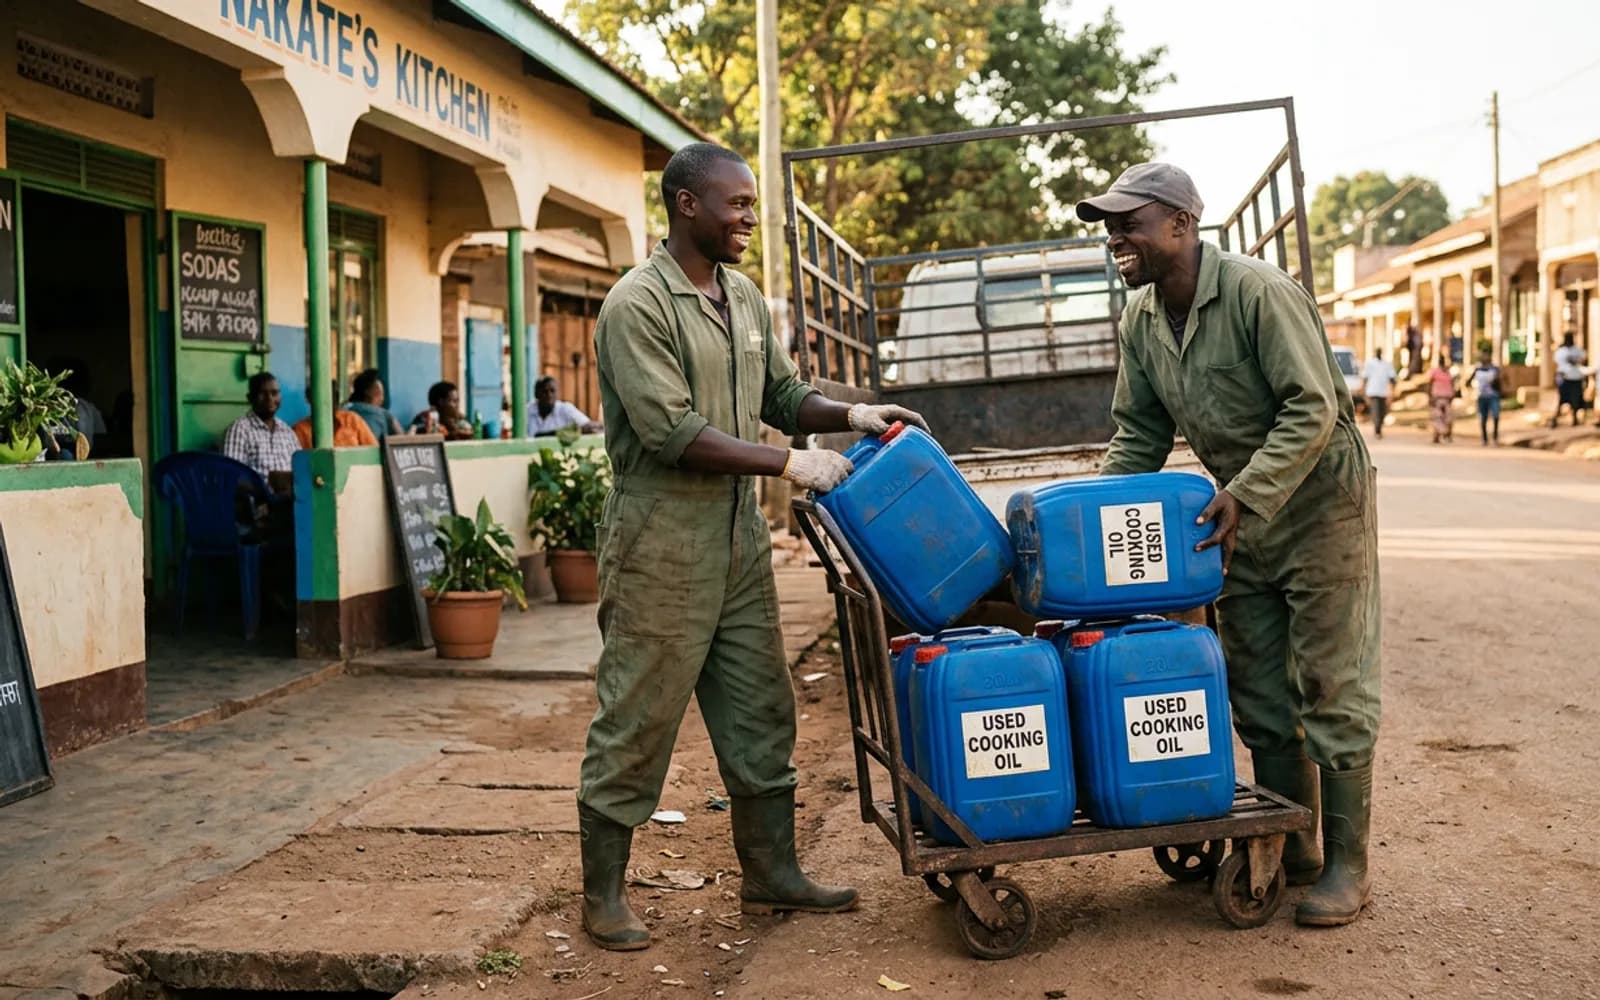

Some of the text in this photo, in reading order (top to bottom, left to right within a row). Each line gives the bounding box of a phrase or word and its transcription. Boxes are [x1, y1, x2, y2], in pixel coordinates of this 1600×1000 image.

[396, 43, 490, 142] KITCHEN
[182, 252, 240, 283] SODAS
[1108, 532, 1125, 558] OIL
[1125, 508, 1145, 580] COOKING
[1145, 522, 1163, 562] USED
[1144, 697, 1187, 716] USED
[982, 712, 1026, 731] USED
[1130, 714, 1205, 737] COOKING
[968, 730, 1044, 753] COOKING
[1156, 736, 1183, 754] OIL
[994, 752, 1022, 770] OIL
